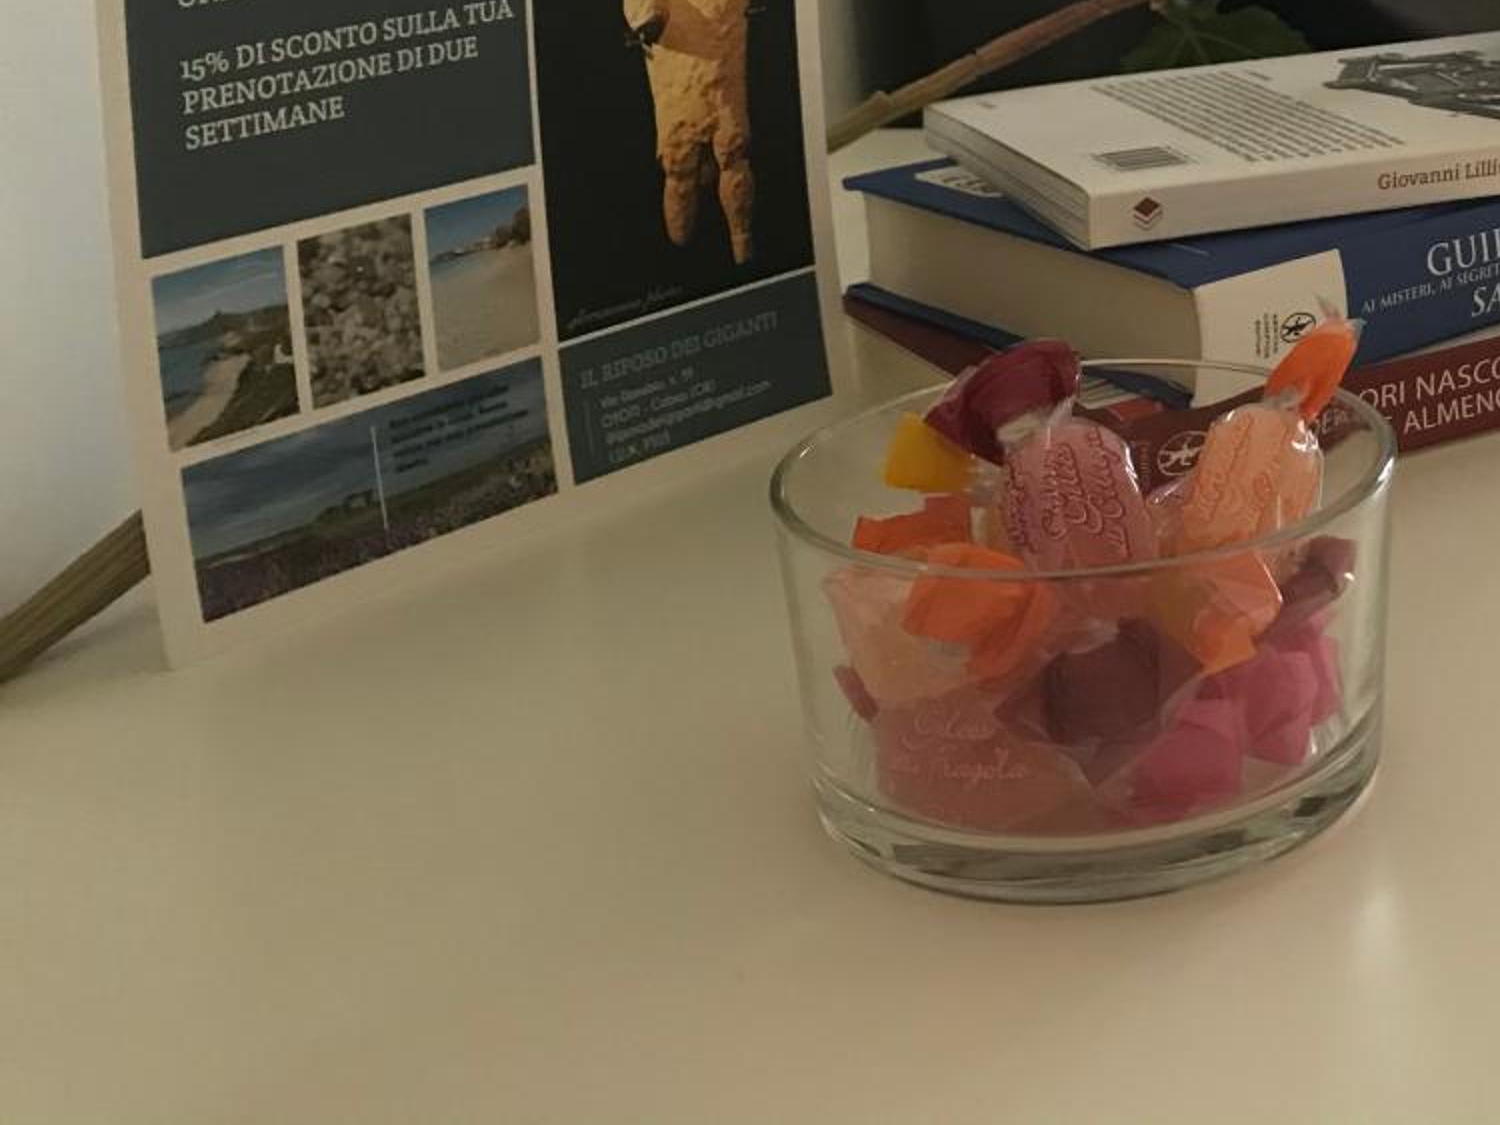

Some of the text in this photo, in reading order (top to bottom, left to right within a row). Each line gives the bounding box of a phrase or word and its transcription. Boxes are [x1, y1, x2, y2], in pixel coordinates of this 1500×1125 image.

[180, 50, 230, 81] 15%
[236, 42, 267, 69] DI
[271, 22, 378, 62] SCONTO
[383, 8, 461, 41] SULLA
[182, 35, 479, 115] PRENOTAZIONE DI DUE
[185, 95, 345, 150] SETTIMANE
[1377, 162, 1460, 190] Giovanni
[601, 346, 668, 381] RIPOSO
[671, 334, 701, 359] DEI
[703, 310, 778, 348] GIGANTI
